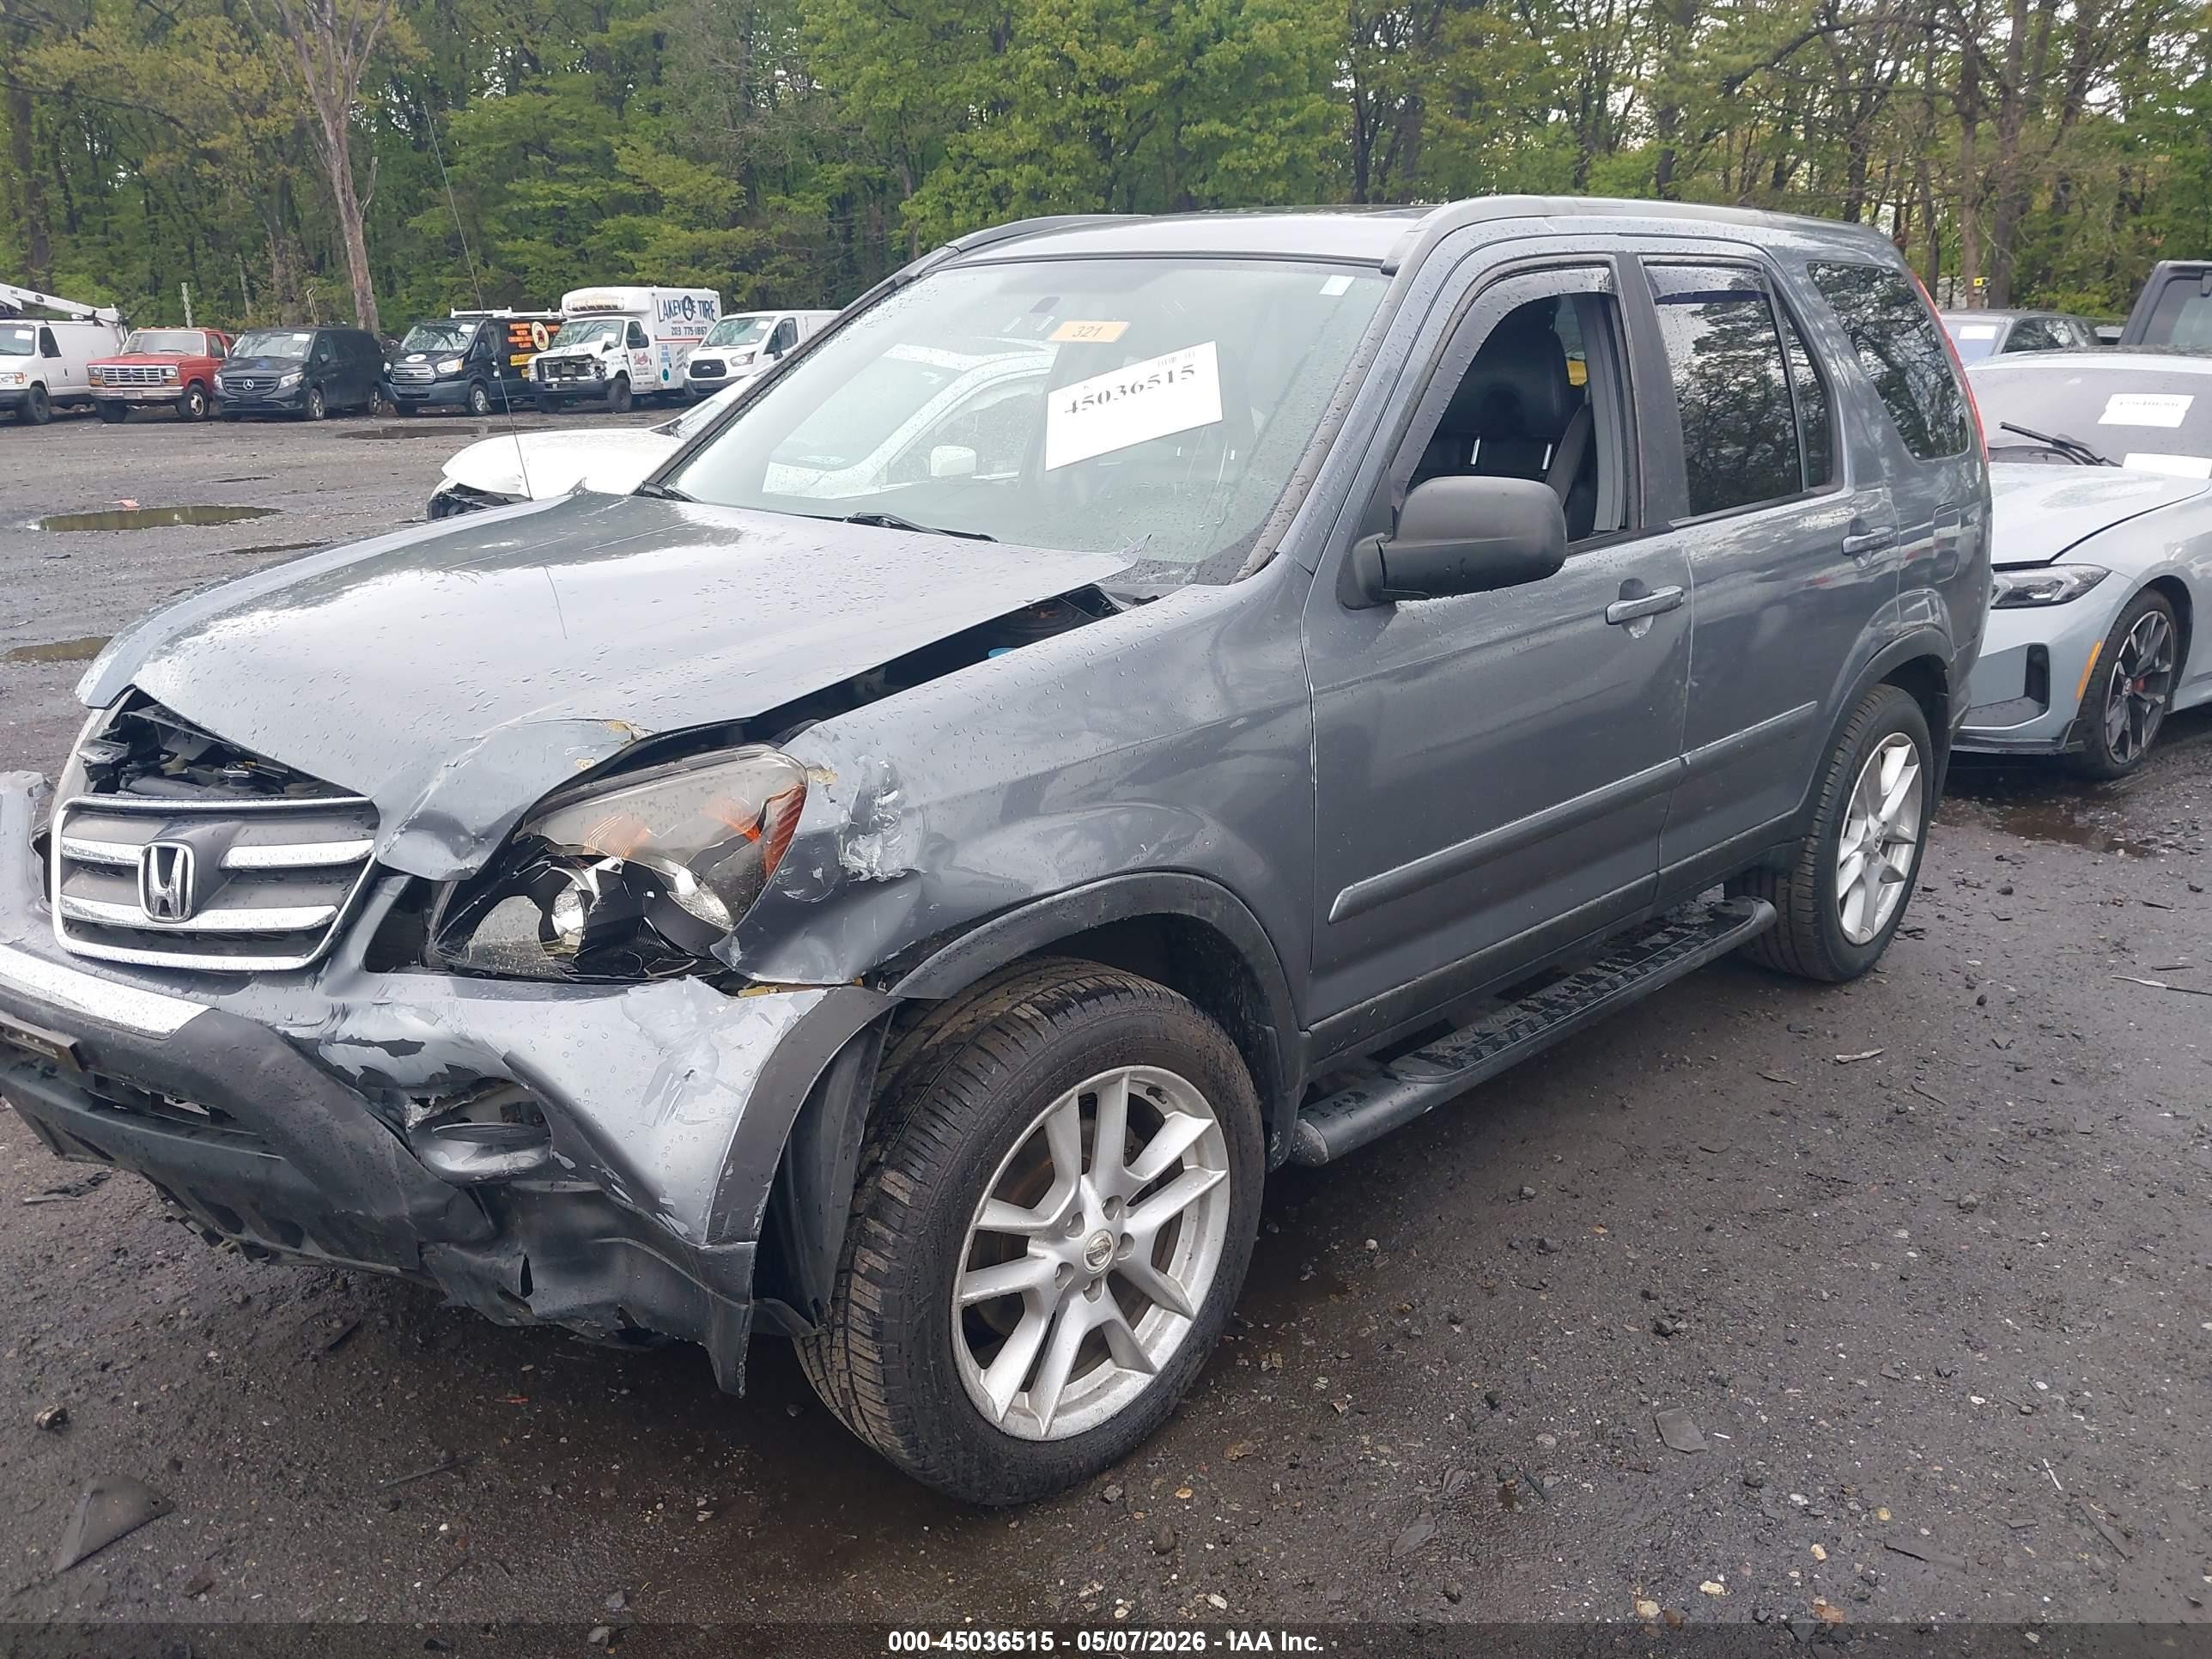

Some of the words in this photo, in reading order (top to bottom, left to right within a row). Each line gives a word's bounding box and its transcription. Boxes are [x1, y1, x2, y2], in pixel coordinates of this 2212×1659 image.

[697, 300, 716, 323] TIRE
[1072, 325, 1103, 337] 321
[1064, 364, 1195, 414] 45036515
